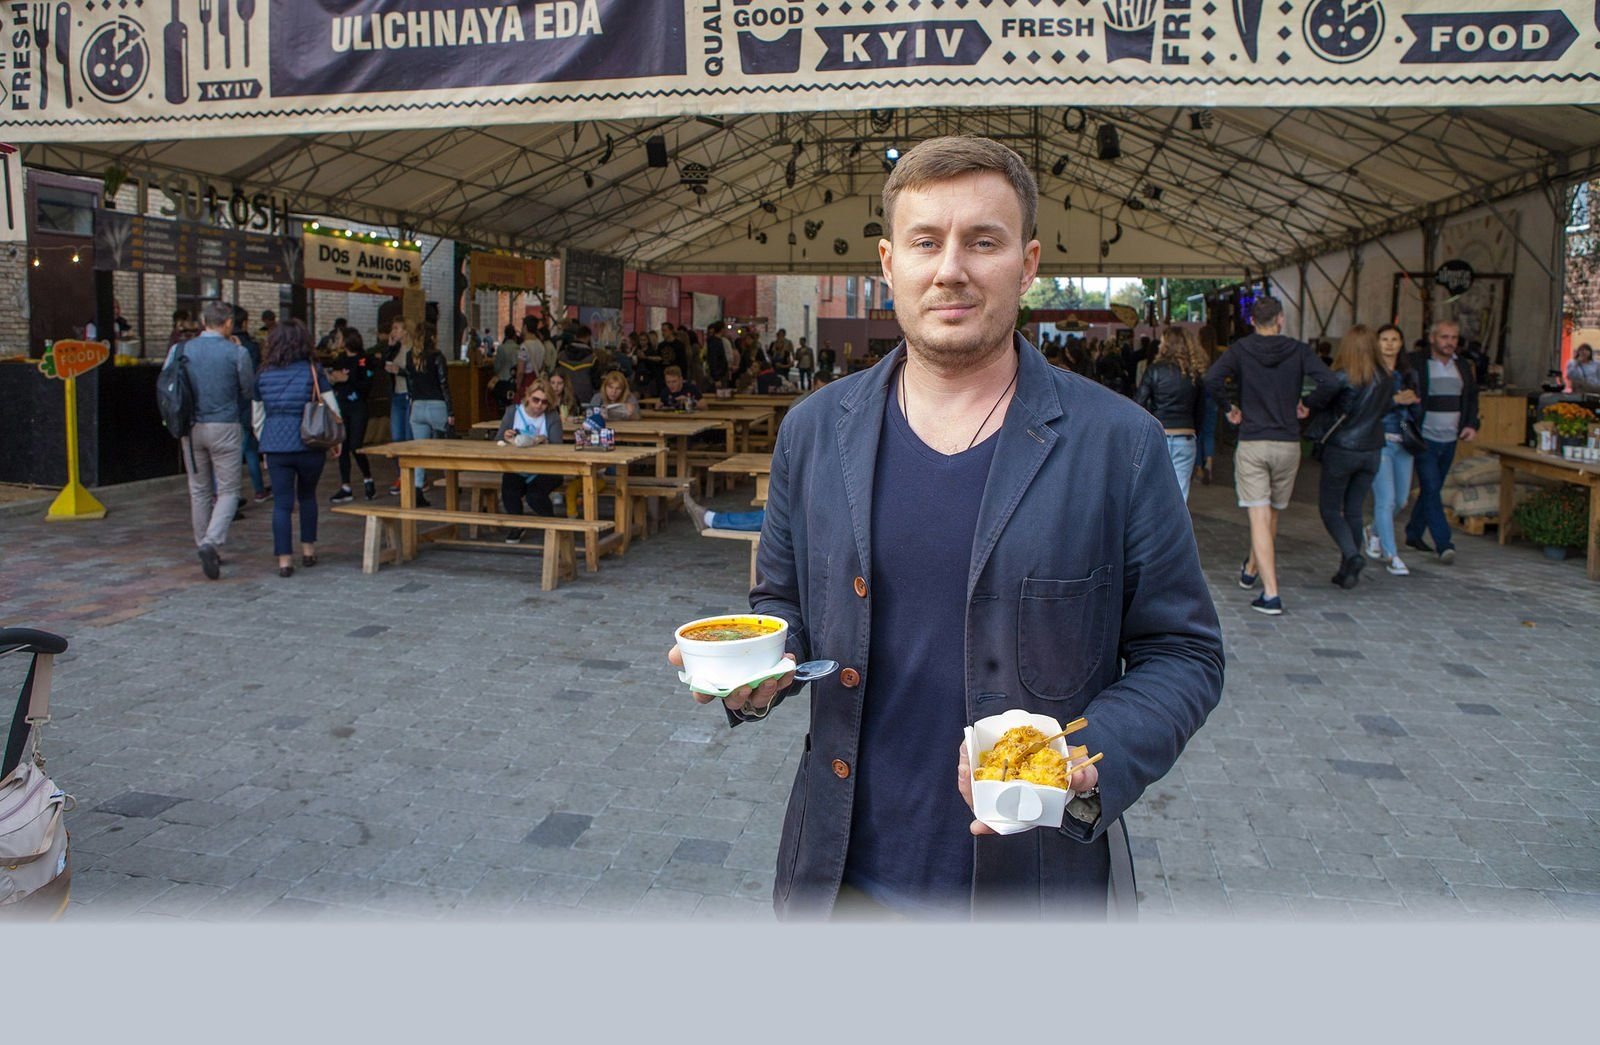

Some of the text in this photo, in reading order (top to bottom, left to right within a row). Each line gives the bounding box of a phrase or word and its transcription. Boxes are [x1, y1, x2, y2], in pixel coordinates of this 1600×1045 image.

[331, 0, 603, 52] ULICHNAYA EDA
[734, 7, 804, 27] GOOD
[1001, 18, 1095, 38] FRESH
[842, 28, 964, 63] KYIV
[1430, 24, 1550, 51] FOOD
[11, 2, 31, 110] FRESH
[207, 82, 254, 98] KYIV
[318, 244, 411, 273] DOS AMIGOS
